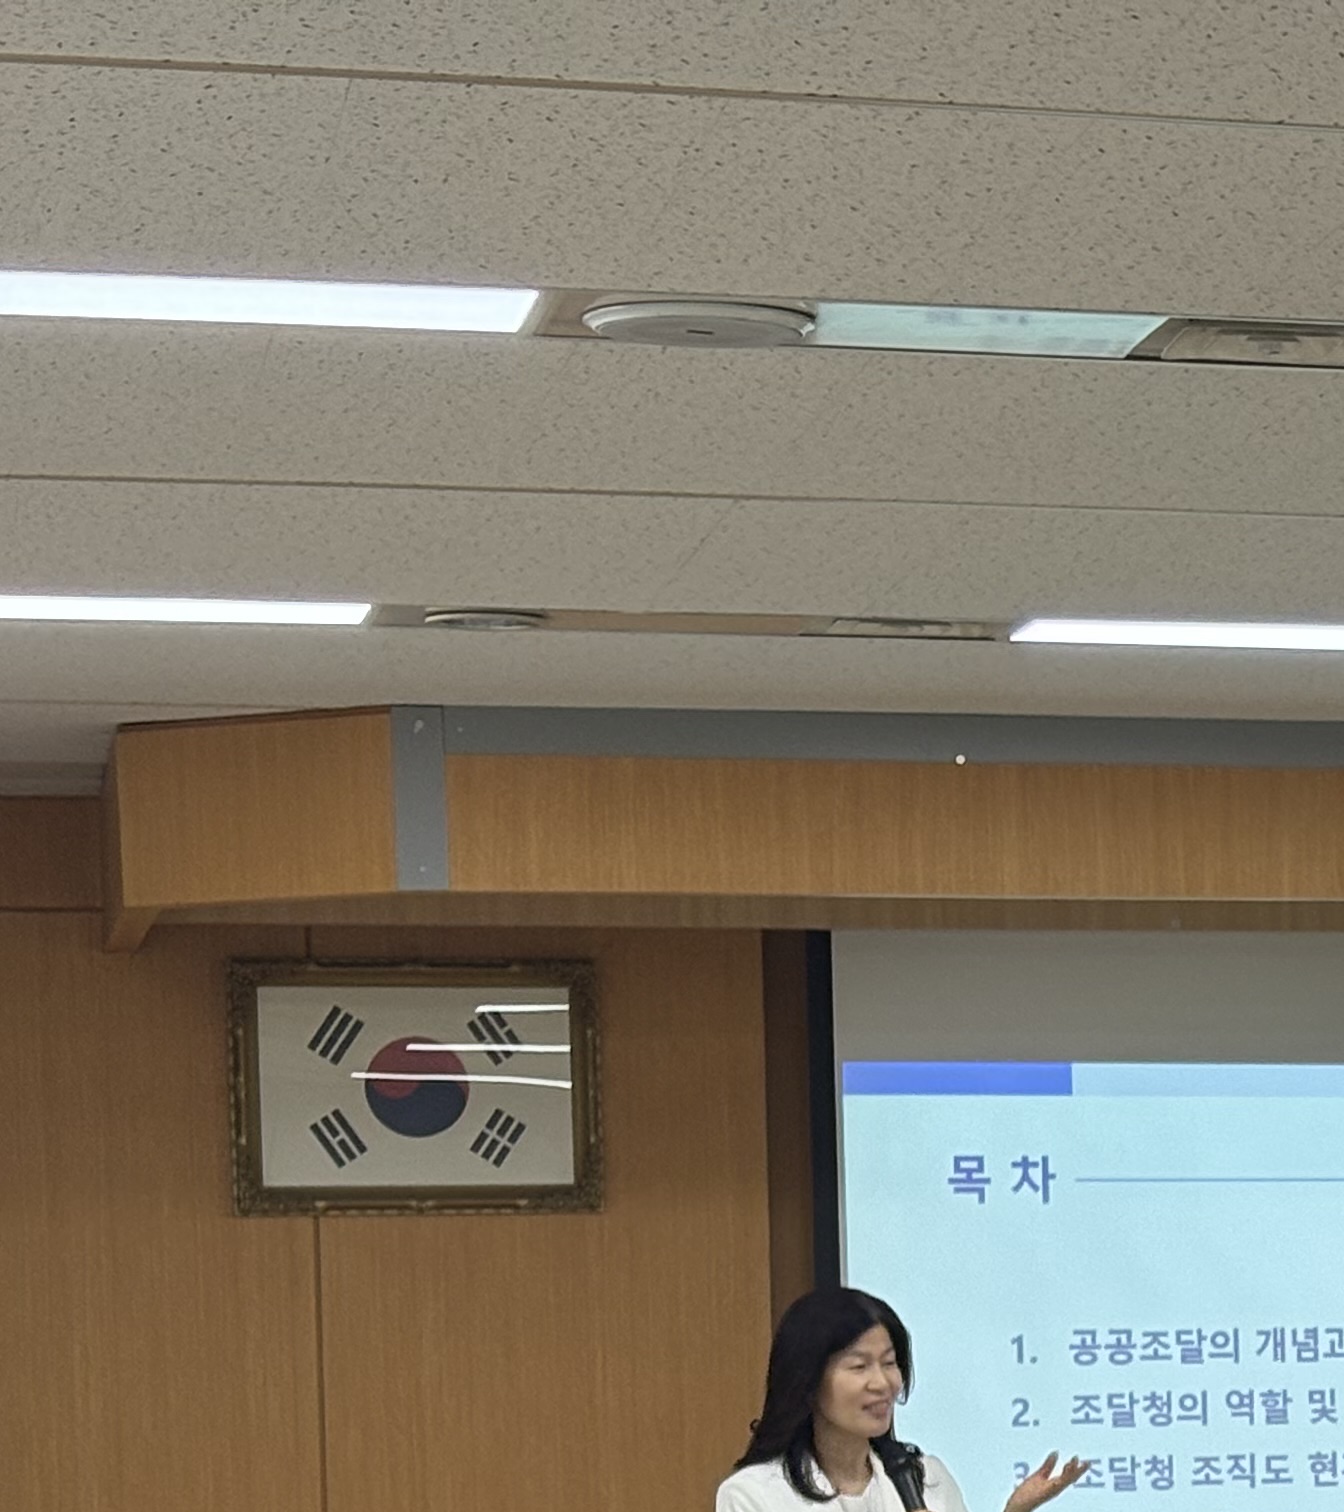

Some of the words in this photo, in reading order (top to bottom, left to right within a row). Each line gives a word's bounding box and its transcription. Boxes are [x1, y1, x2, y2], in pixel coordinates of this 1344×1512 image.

[1010, 1333, 1038, 1365] 1.
[1069, 1327, 1240, 1366] 공공조달의
[1011, 1397, 1040, 1428] 2.
[1070, 1389, 1208, 1428] 조달청의
[1225, 1388, 1294, 1426] 역할
[1307, 1388, 1339, 1425] 및
[1073, 1453, 1176, 1492] 조달청
[1191, 1451, 1295, 1489] 조직도
